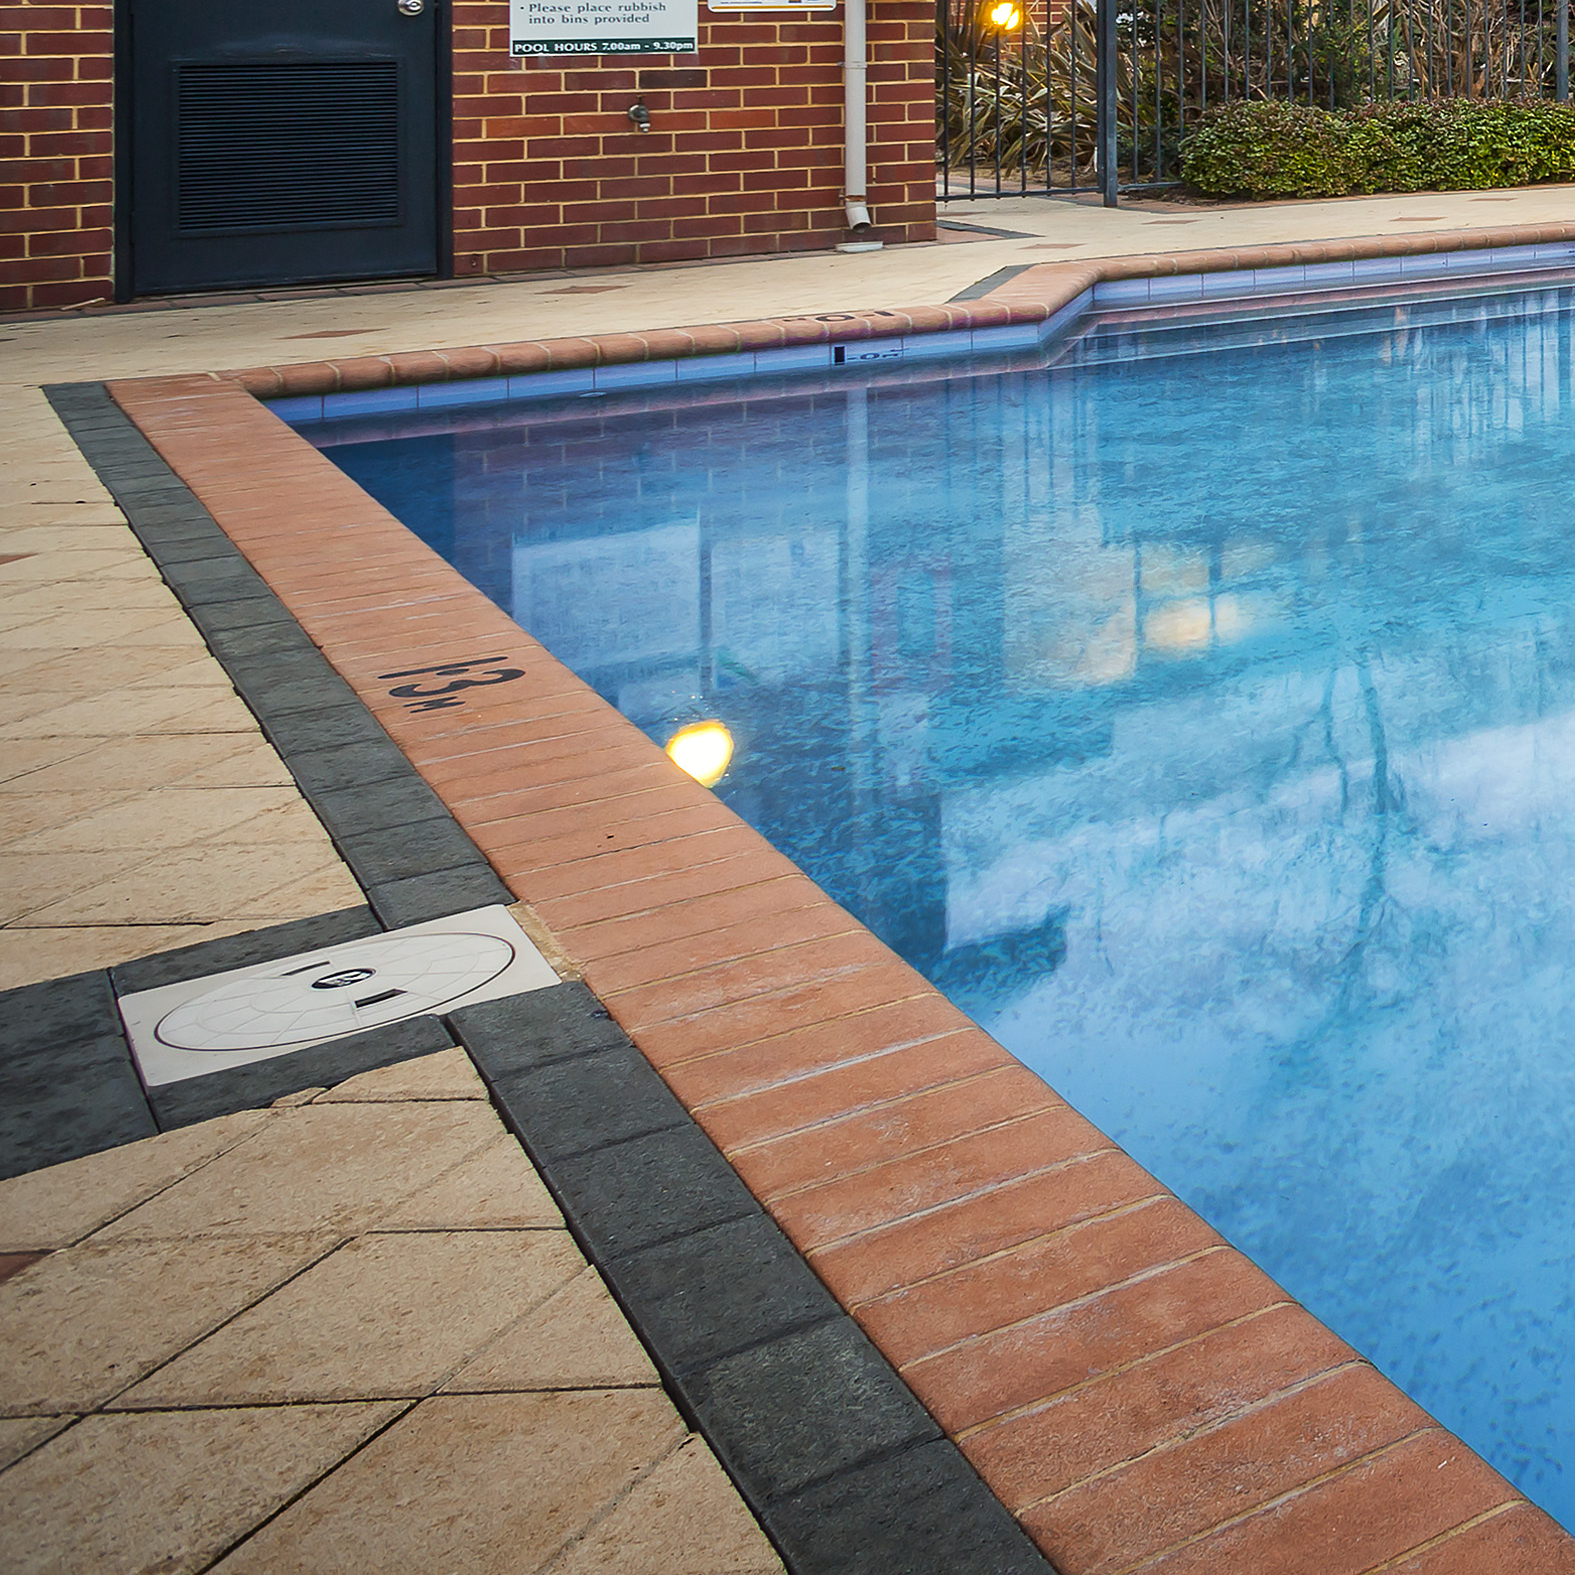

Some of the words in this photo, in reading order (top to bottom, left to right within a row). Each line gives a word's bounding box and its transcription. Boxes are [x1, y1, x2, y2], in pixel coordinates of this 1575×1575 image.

[529, 3, 571, 13] Please
[577, 2, 612, 14] place
[618, 2, 666, 12] rubbish
[529, 15, 555, 24] into
[561, 14, 589, 24] bins
[594, 14, 650, 25] provided
[514, 43, 549, 53] POOL
[554, 42, 598, 52] HOURS
[601, 42, 641, 51] 7.00am
[652, 41, 693, 51] 9.30pm
